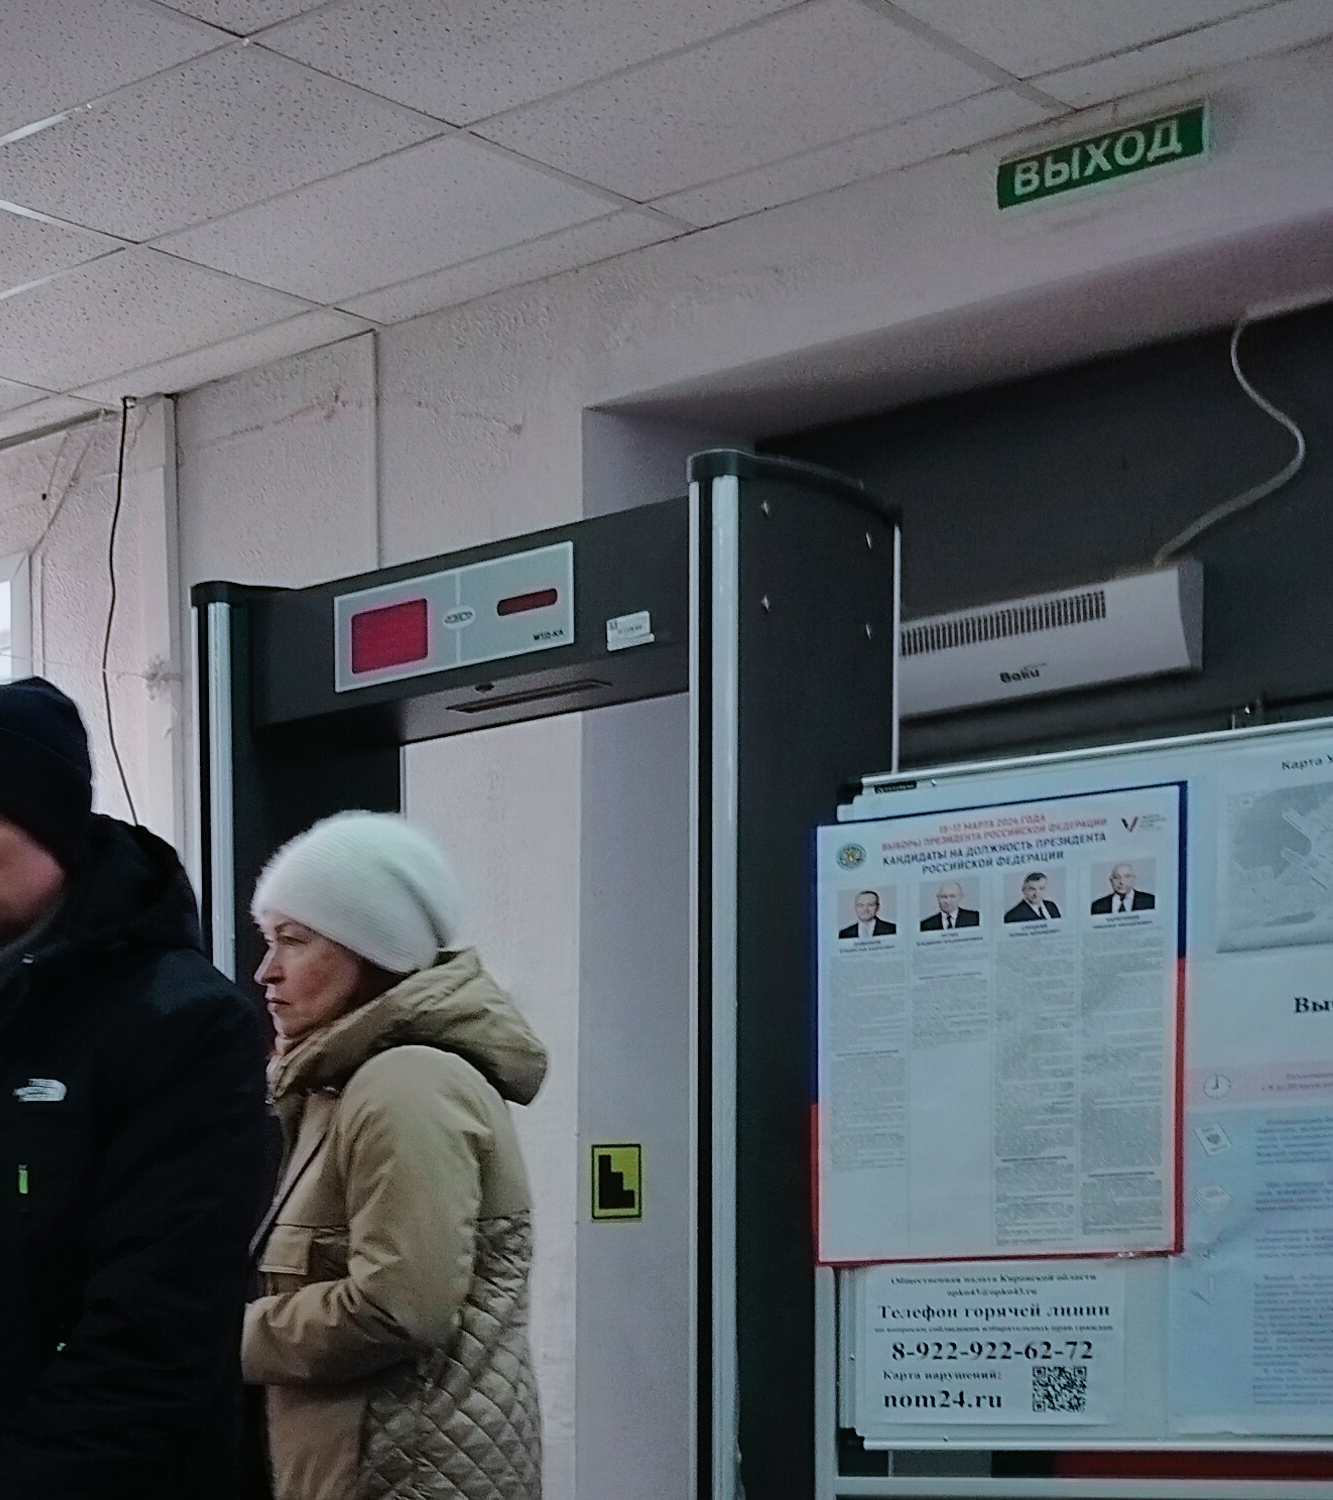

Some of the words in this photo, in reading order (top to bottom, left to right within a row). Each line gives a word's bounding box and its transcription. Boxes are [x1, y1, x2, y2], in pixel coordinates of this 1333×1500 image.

[1014, 118, 1183, 196] ВЫХОД
[882, 850, 947, 866] КАНДИДАТЫ
[949, 847, 964, 858] НА
[965, 841, 1033, 857] ДОЛЖНОСТЬ
[1035, 832, 1107, 848] ПРЕЗИДЕНТА
[922, 858, 993, 875] РОССИЙСКОЙ
[996, 850, 1064, 867] ФЕДЕРАЦИИ
[1293, 996, 1333, 1013] Вы
[878, 1303, 958, 1322] Телефон
[964, 1302, 1041, 1322] горячей
[1047, 1305, 1110, 1318] линии
[891, 1340, 1094, 1361] 8-922-922-62-72
[883, 1369, 921, 1382] Карта
[883, 1389, 1003, 1409] nom24.ru
